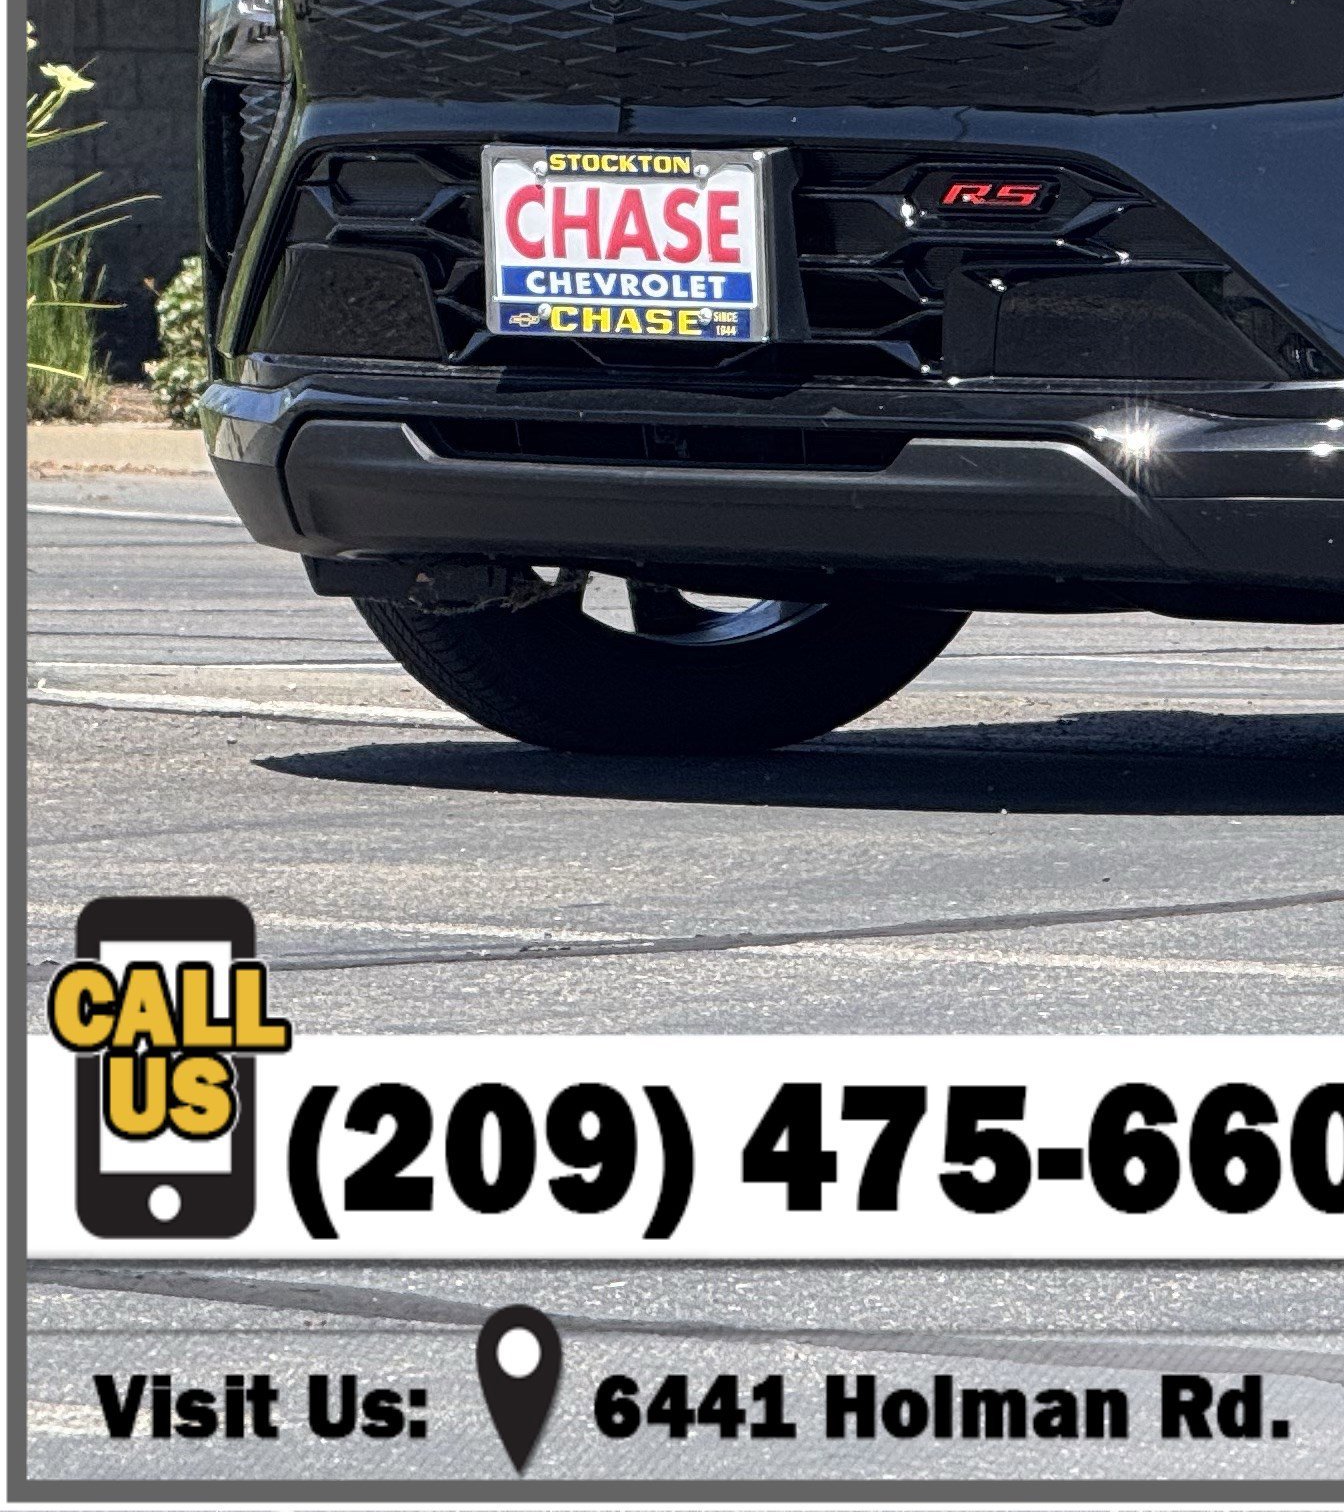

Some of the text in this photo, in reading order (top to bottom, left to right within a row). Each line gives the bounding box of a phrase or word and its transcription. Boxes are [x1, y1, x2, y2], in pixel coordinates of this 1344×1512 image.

[548, 152, 691, 174] STOCKTON
[941, 182, 1043, 207] RS
[505, 184, 742, 264] CHASE
[525, 270, 727, 300] CHEVROLET
[550, 306, 704, 337] CHASE
